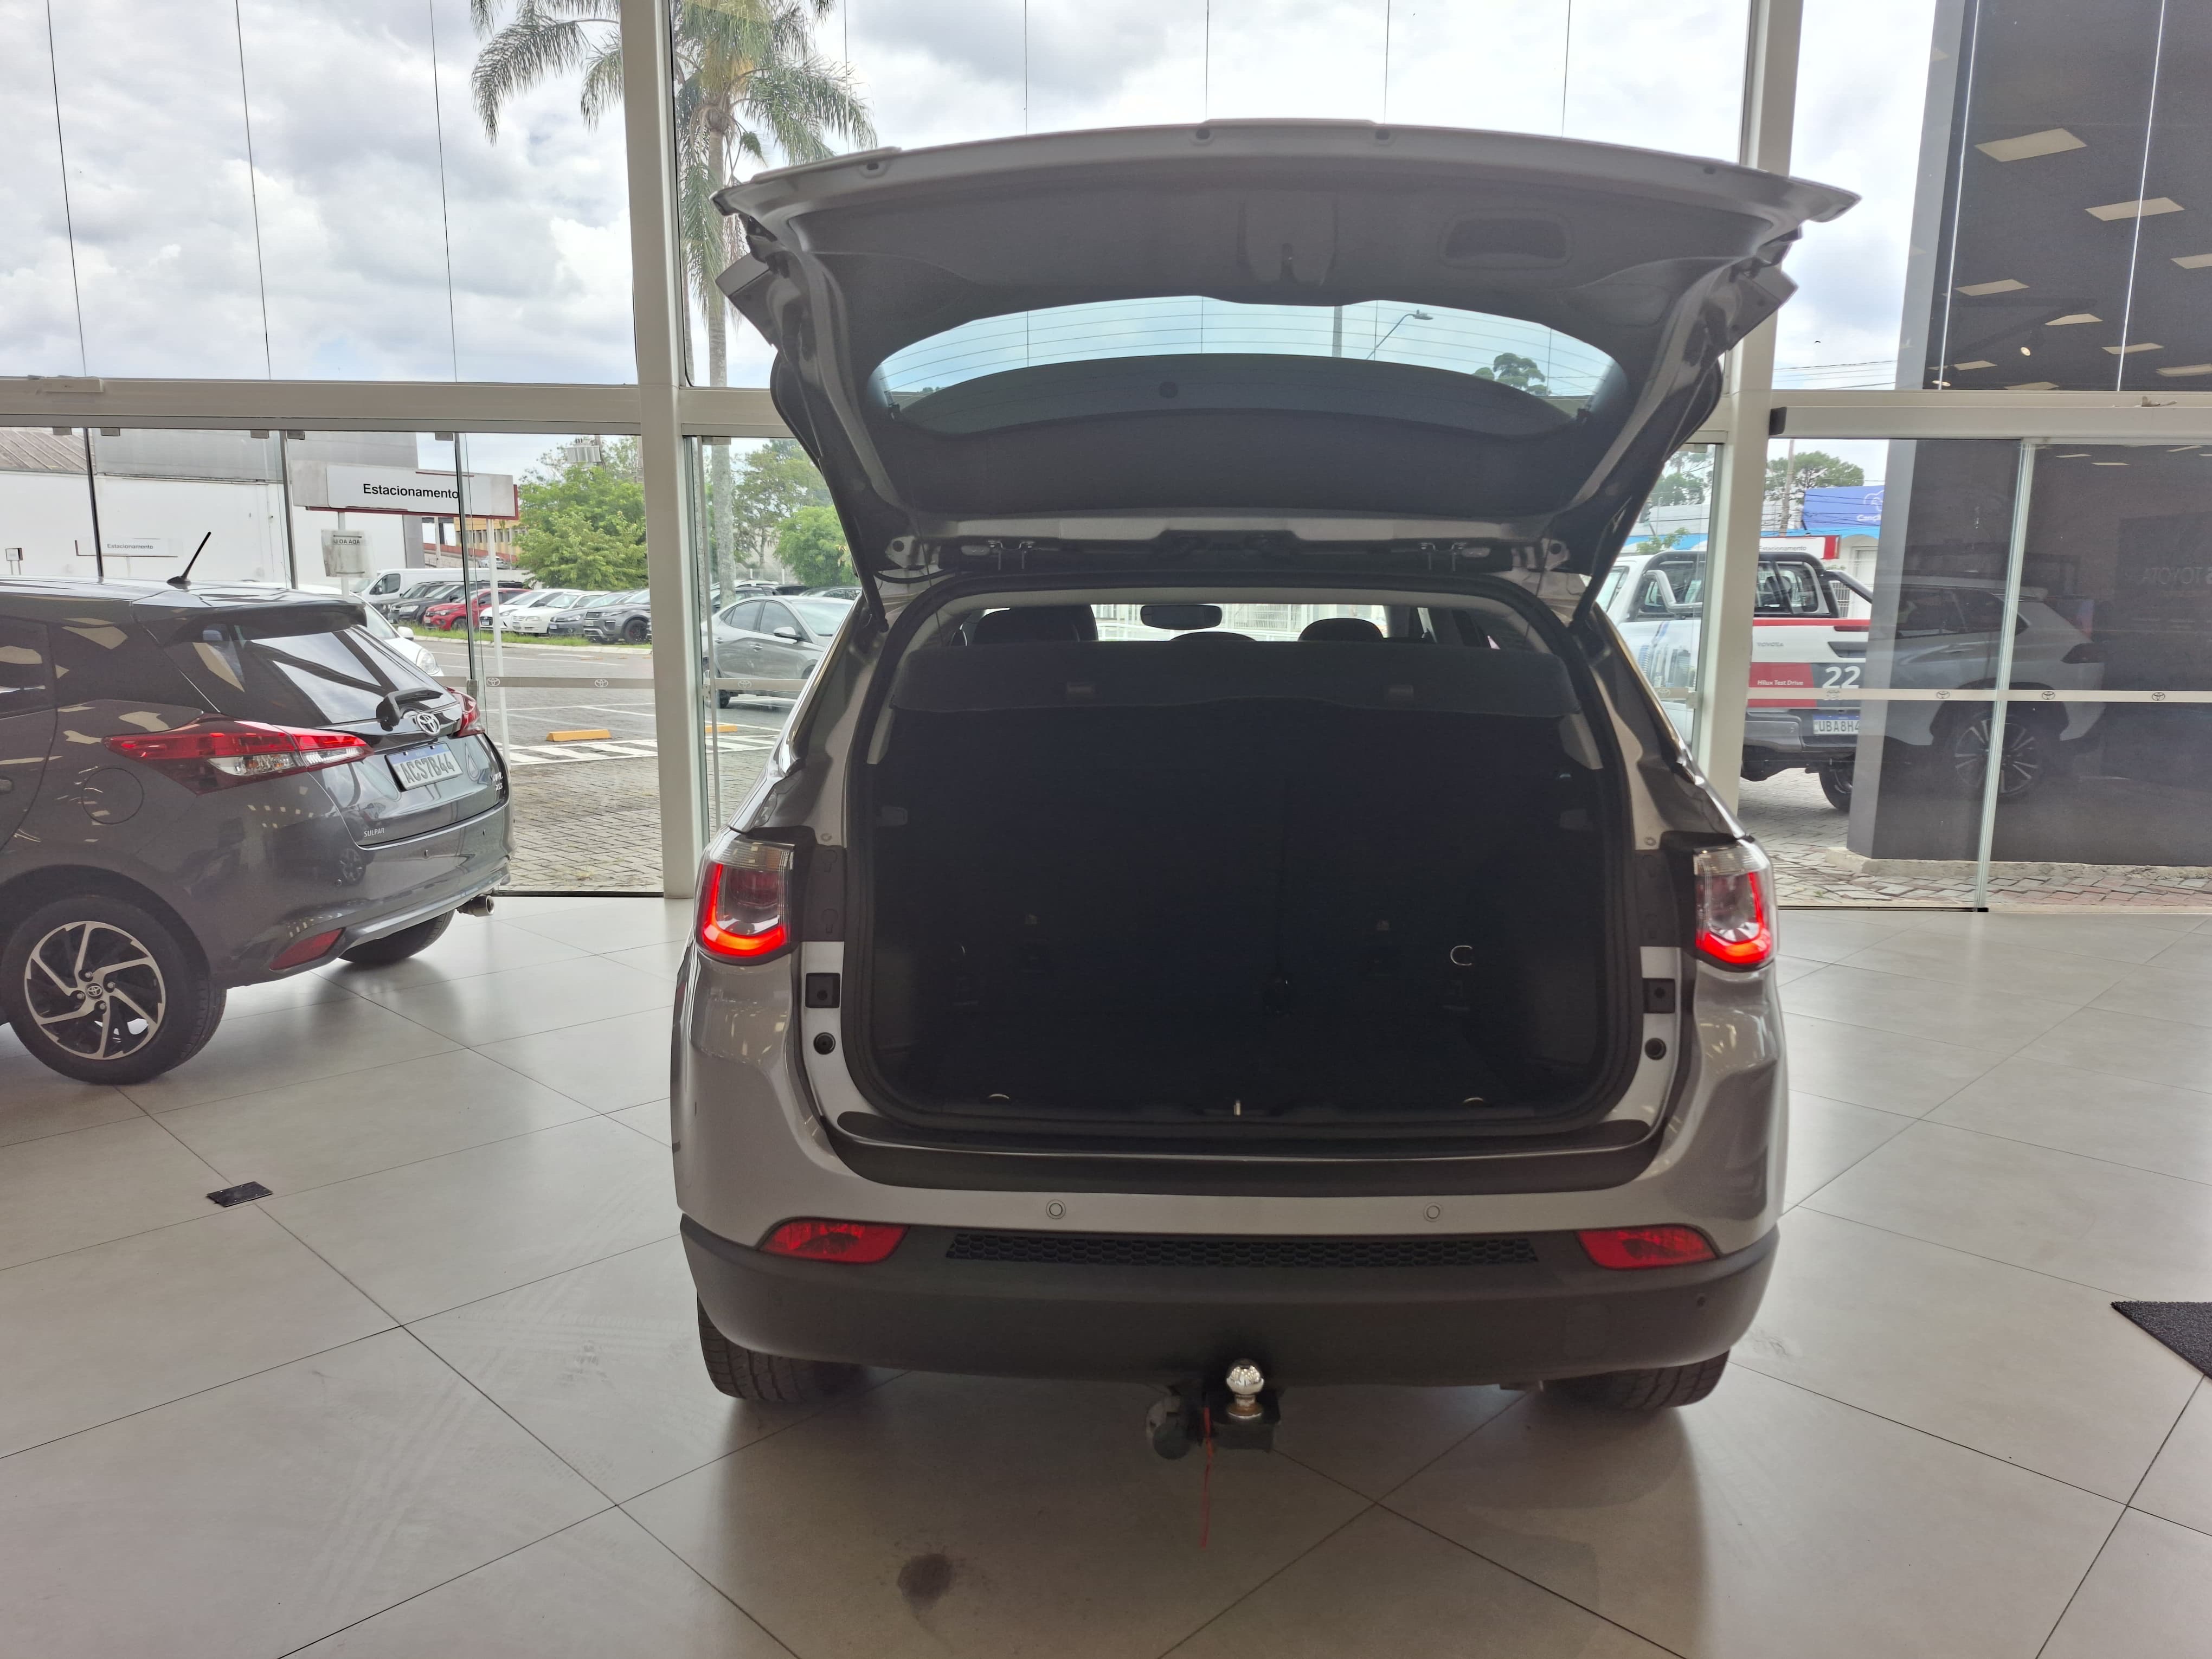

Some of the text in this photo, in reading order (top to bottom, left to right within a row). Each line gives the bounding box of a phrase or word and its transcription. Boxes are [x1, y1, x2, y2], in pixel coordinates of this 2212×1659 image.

[363, 483, 459, 499] Estacionamento
[1822, 666, 1861, 689] 22
[1819, 720, 1860, 732] UBA8H4
[400, 753, 455, 783] ACS7B44
[364, 827, 385, 838] SULPAR
